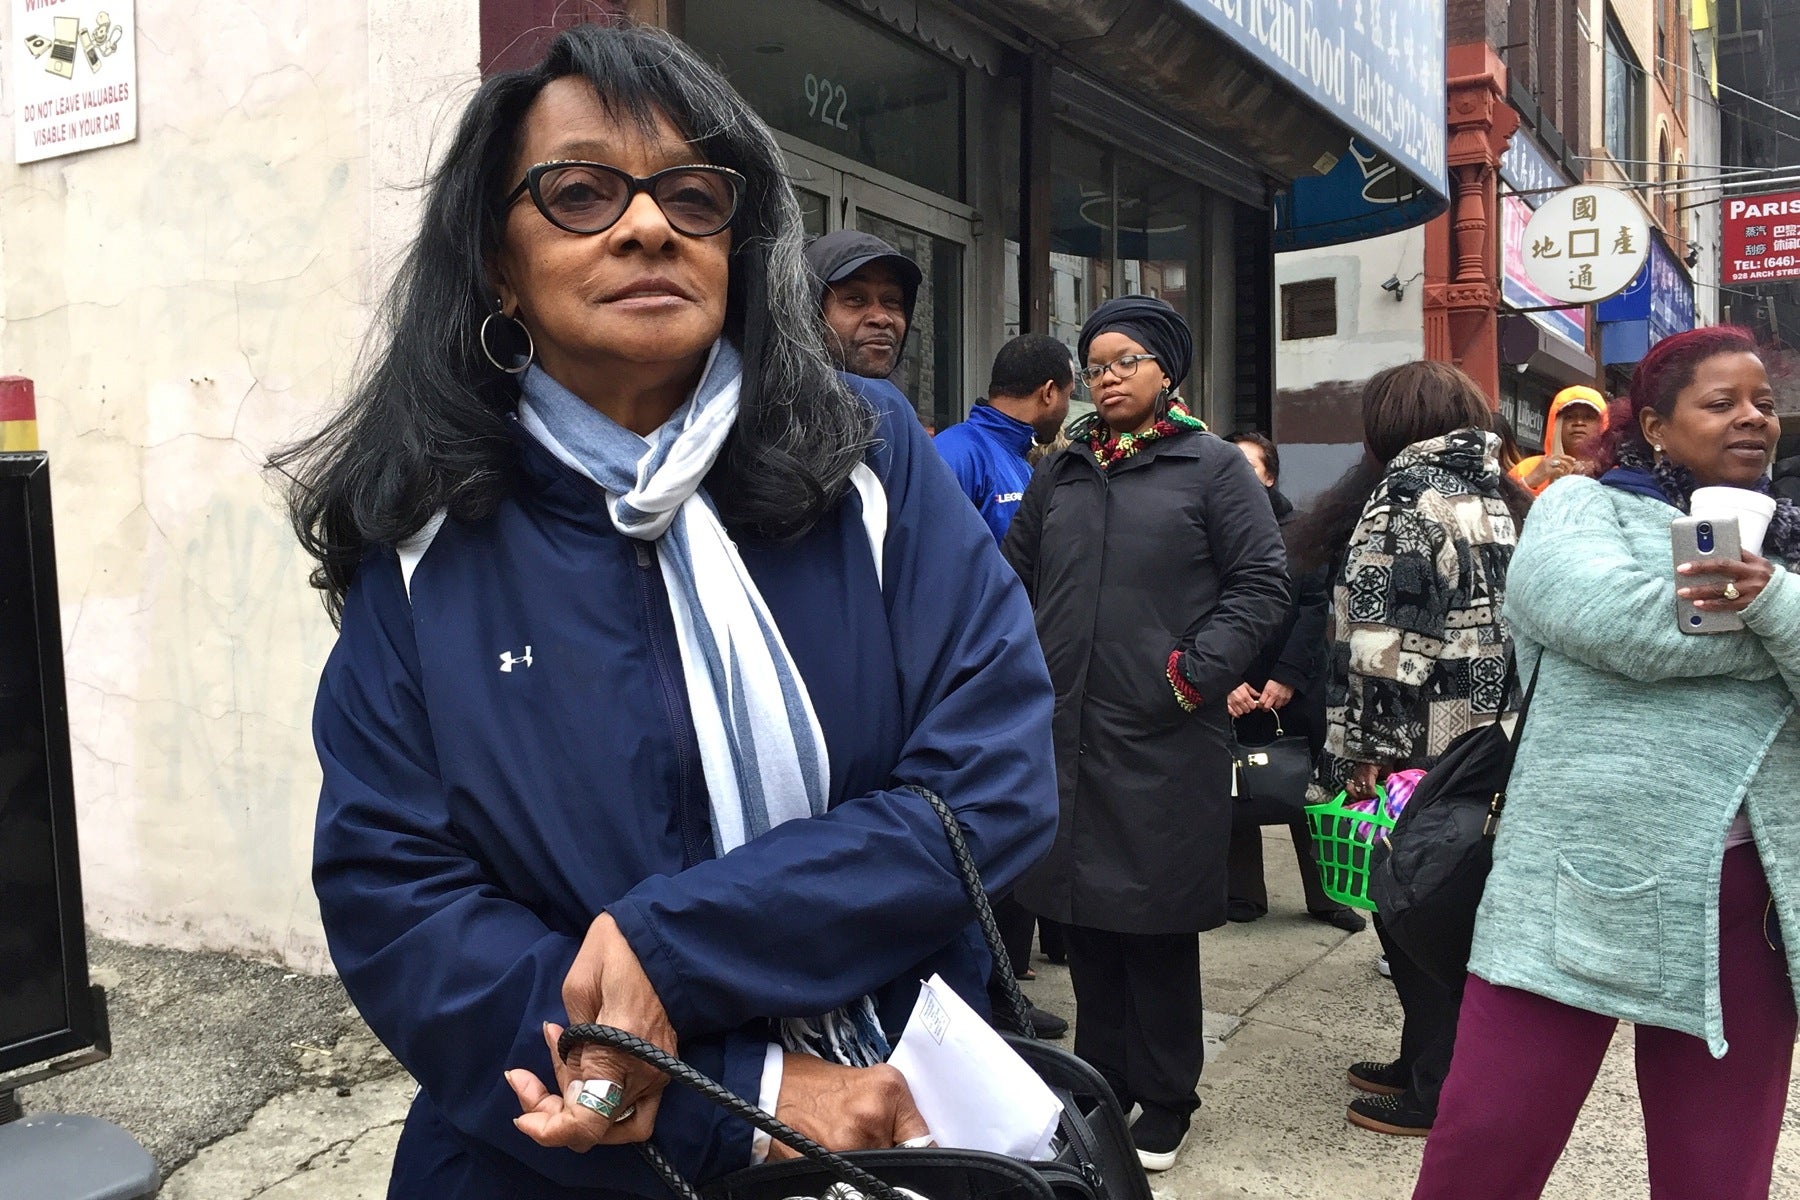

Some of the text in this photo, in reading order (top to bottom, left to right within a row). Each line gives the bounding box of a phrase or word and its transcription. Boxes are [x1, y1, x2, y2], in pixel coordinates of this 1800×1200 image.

[1298, 0, 1346, 105] Food
[25, 82, 129, 122] DO NOT LEAVE VALUABLES
[804, 73, 848, 131] 922
[34, 112, 120, 147] VISABLE IN YOUR CAR
[1572, 195, 1597, 221] 國
[1730, 200, 1800, 220] PARIS
[1610, 226, 1636, 255] 產
[1773, 225, 1800, 238] 巴黎
[1532, 235, 1562, 258] 地
[1568, 263, 1598, 291] 通
[1732, 268, 1800, 281] 928 ARCH STRE
[1734, 260, 1760, 271] TEL:
